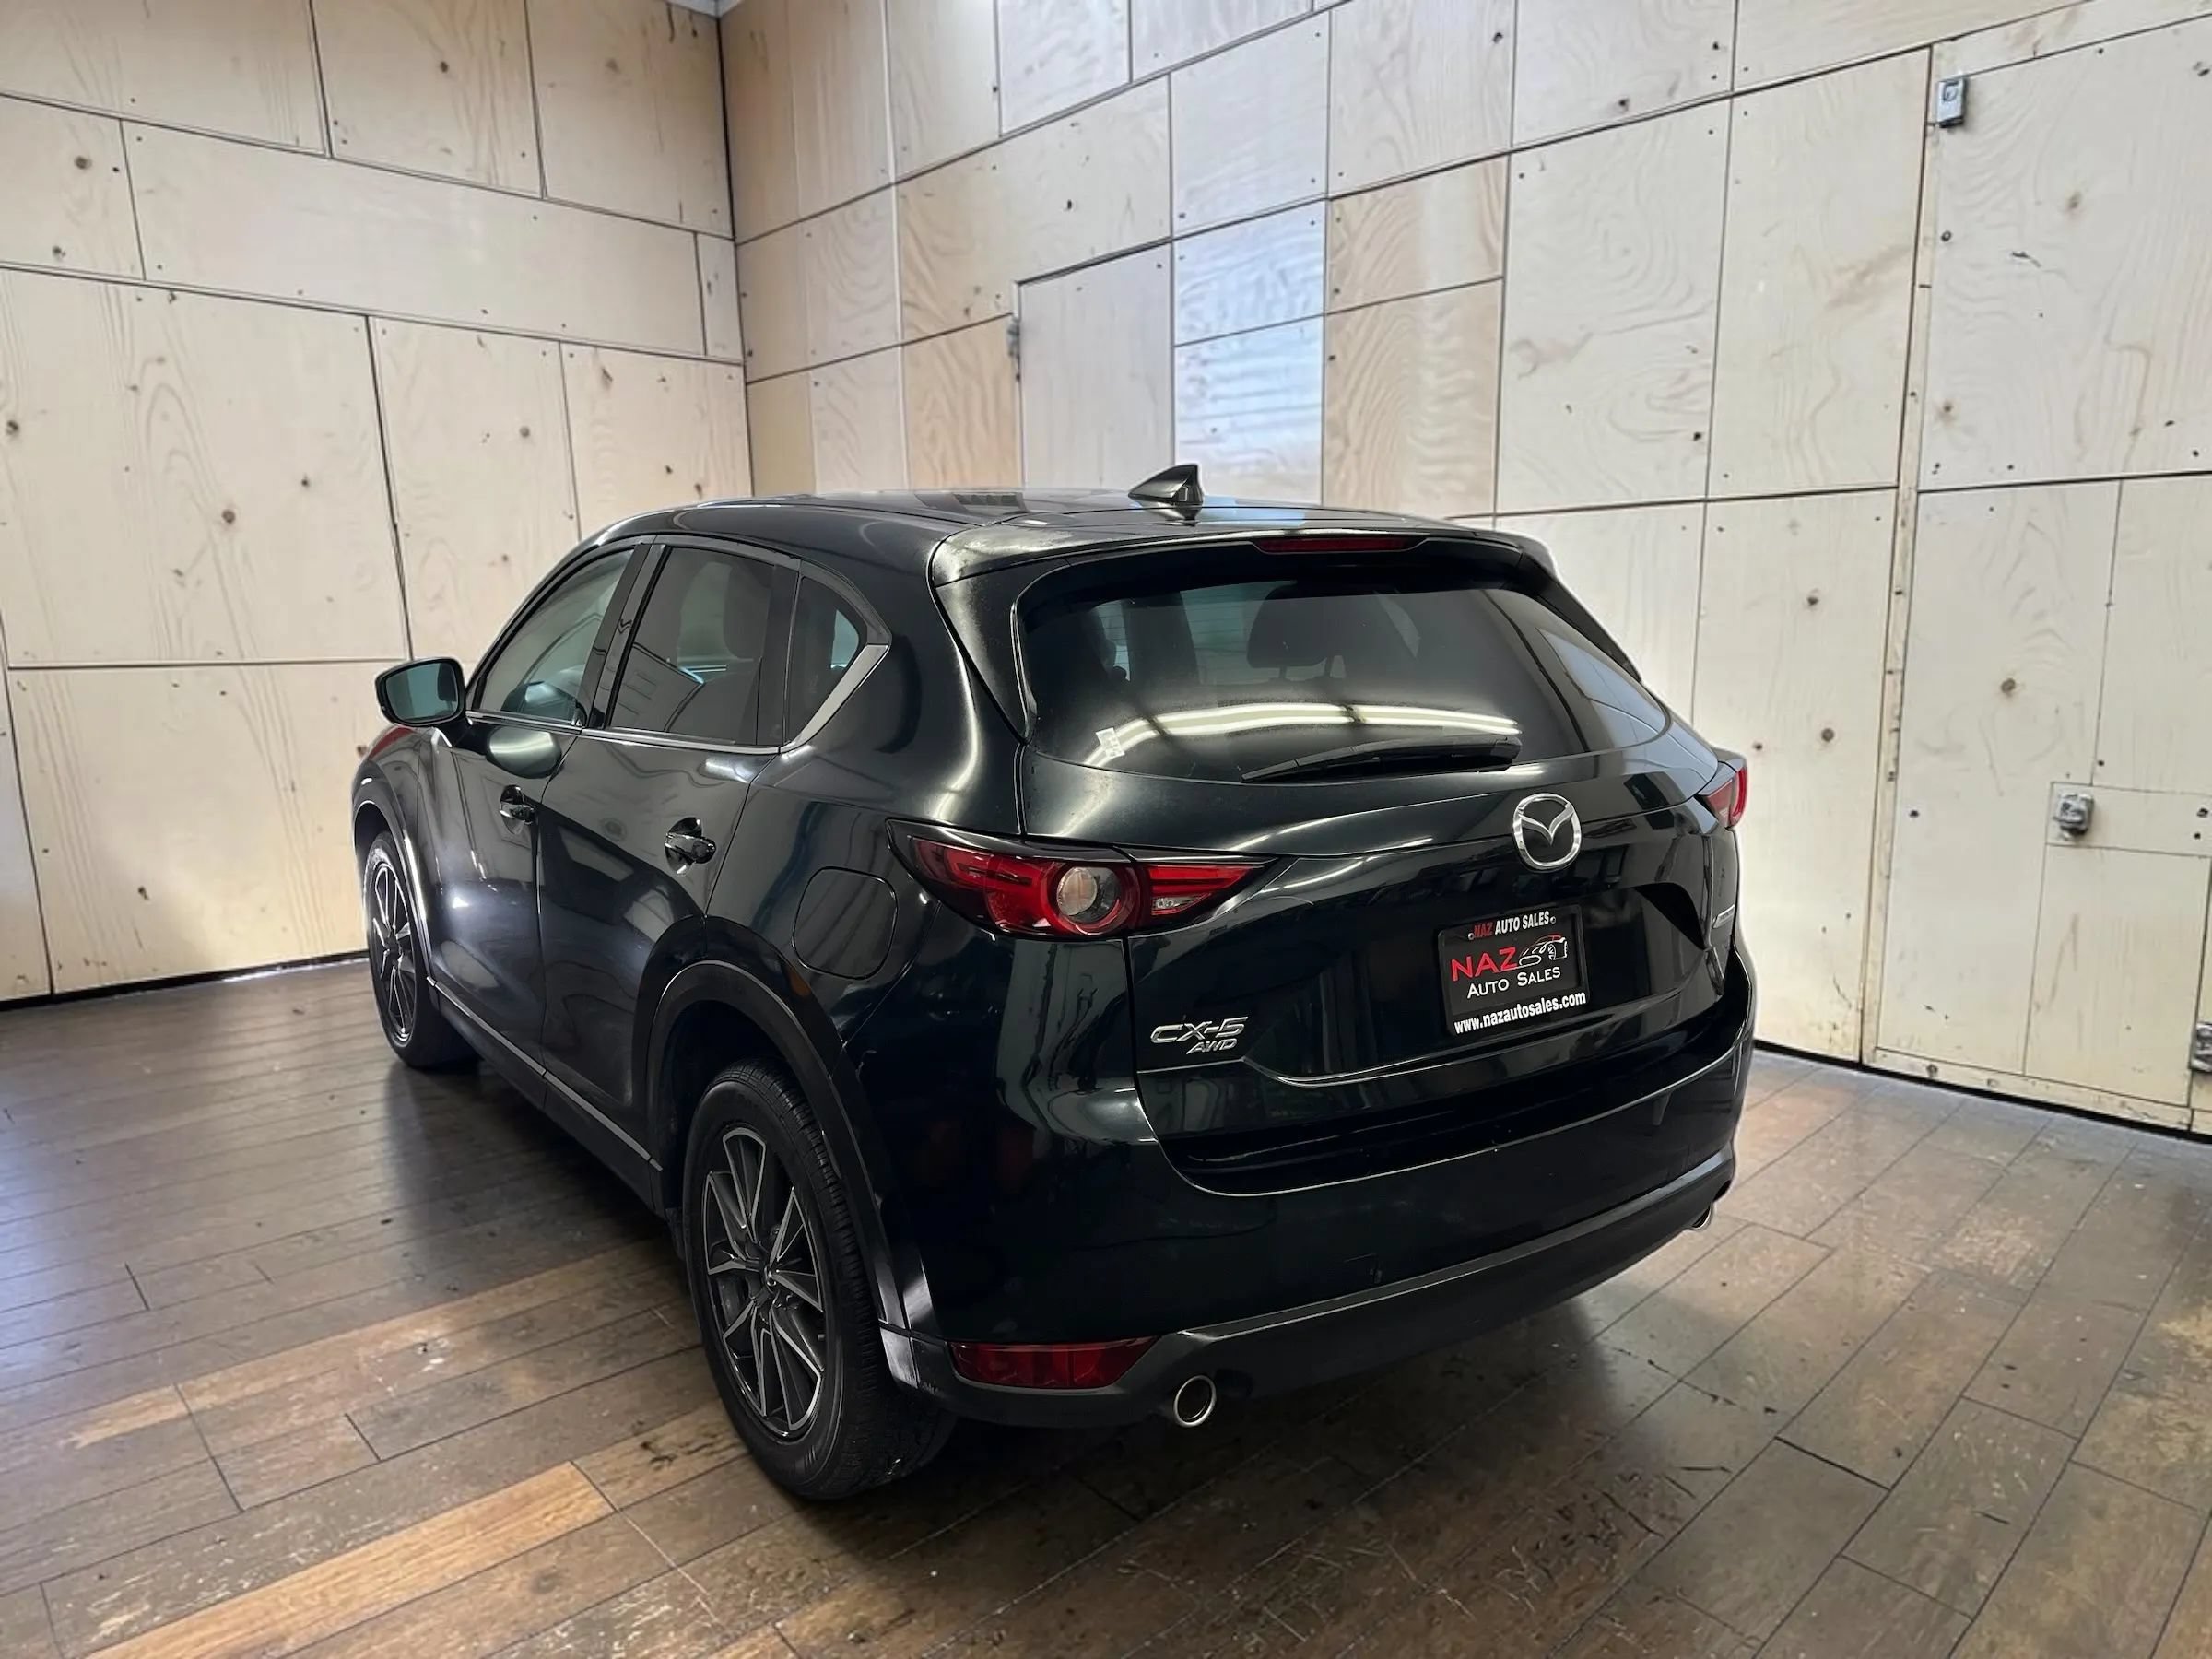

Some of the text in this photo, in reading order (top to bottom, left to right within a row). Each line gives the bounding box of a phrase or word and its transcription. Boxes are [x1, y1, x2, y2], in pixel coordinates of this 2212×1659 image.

[1474, 911, 1550, 937] NAZ AUTO SALES
[1451, 947, 1518, 982] NAZ
[1467, 967, 1561, 999] AUTO SALES
[1454, 992, 1587, 1034] www.nazautosales.com
[1150, 1017, 1249, 1043] CX-5
[1186, 1038, 1238, 1054] AWD
